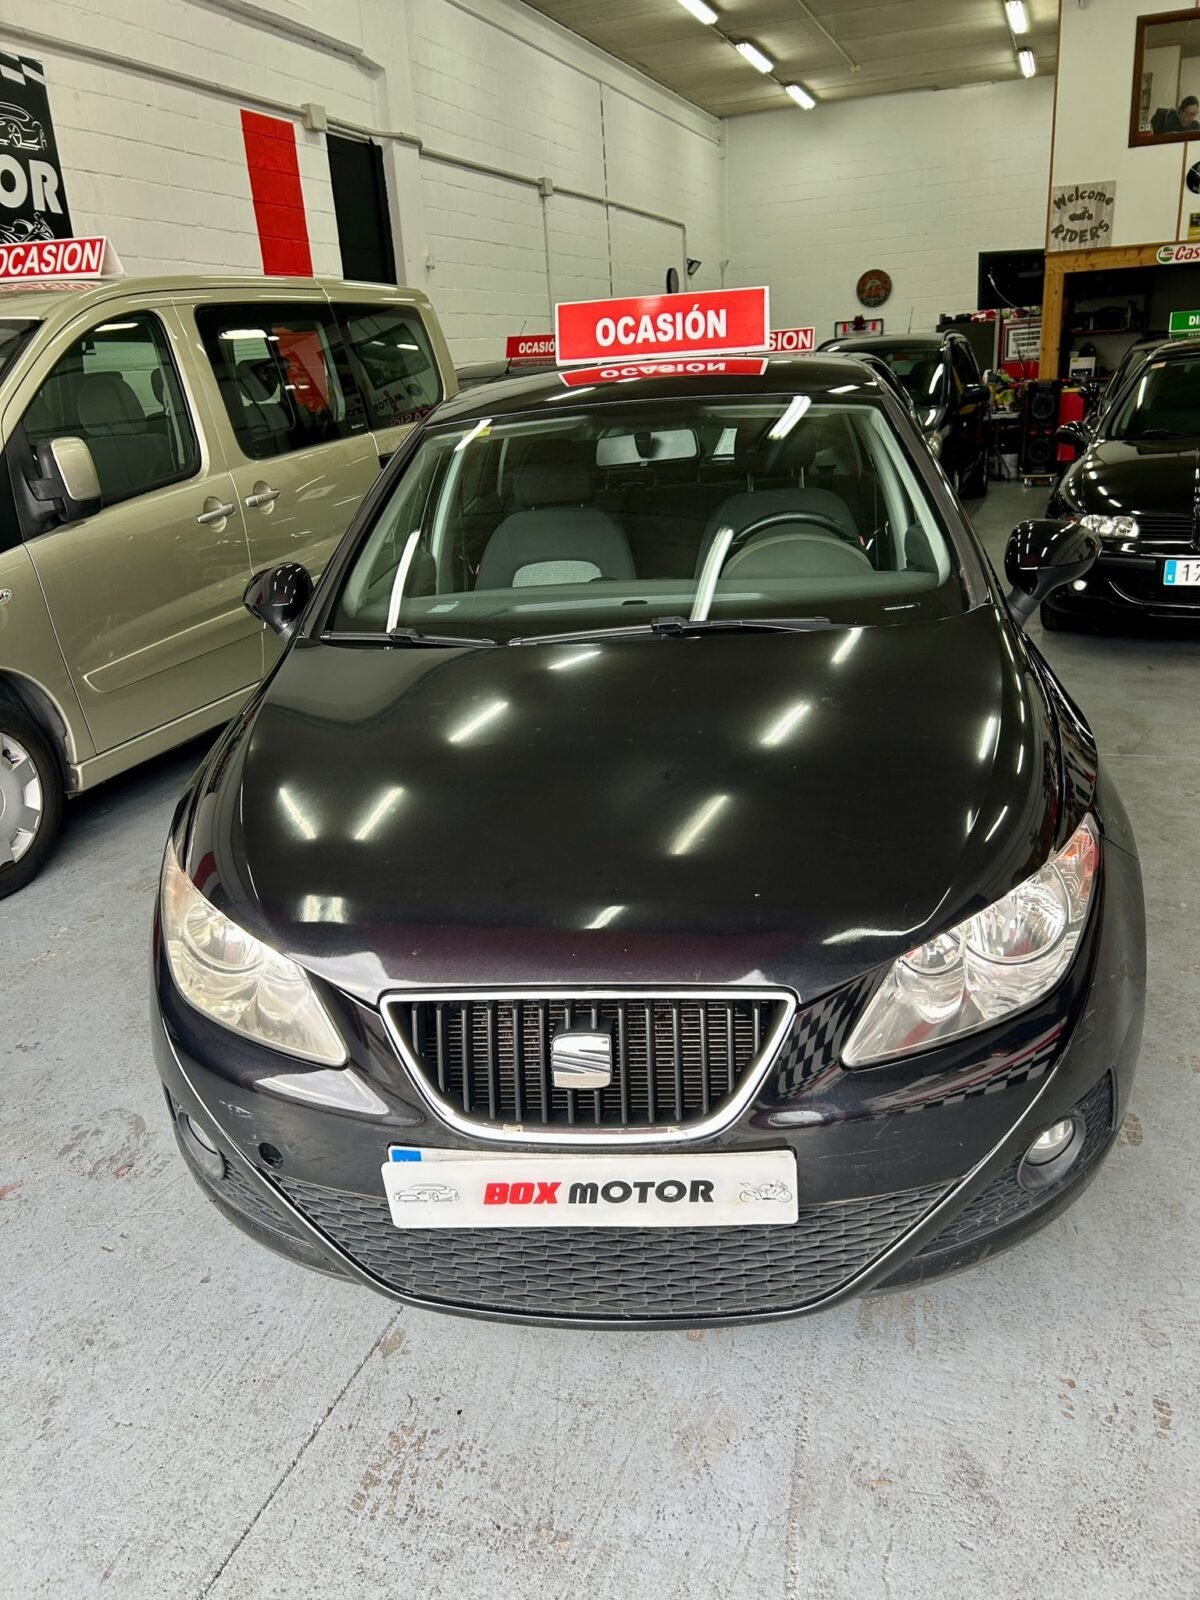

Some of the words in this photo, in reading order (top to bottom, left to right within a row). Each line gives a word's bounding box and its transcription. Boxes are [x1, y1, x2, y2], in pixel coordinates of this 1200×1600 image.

[1053, 186, 1114, 211] Welcome
[1051, 219, 1109, 244] RIDERS
[595, 304, 727, 347] OCASIÓN
[483, 1181, 562, 1205] BOX
[568, 1180, 714, 1203] MOTOR
